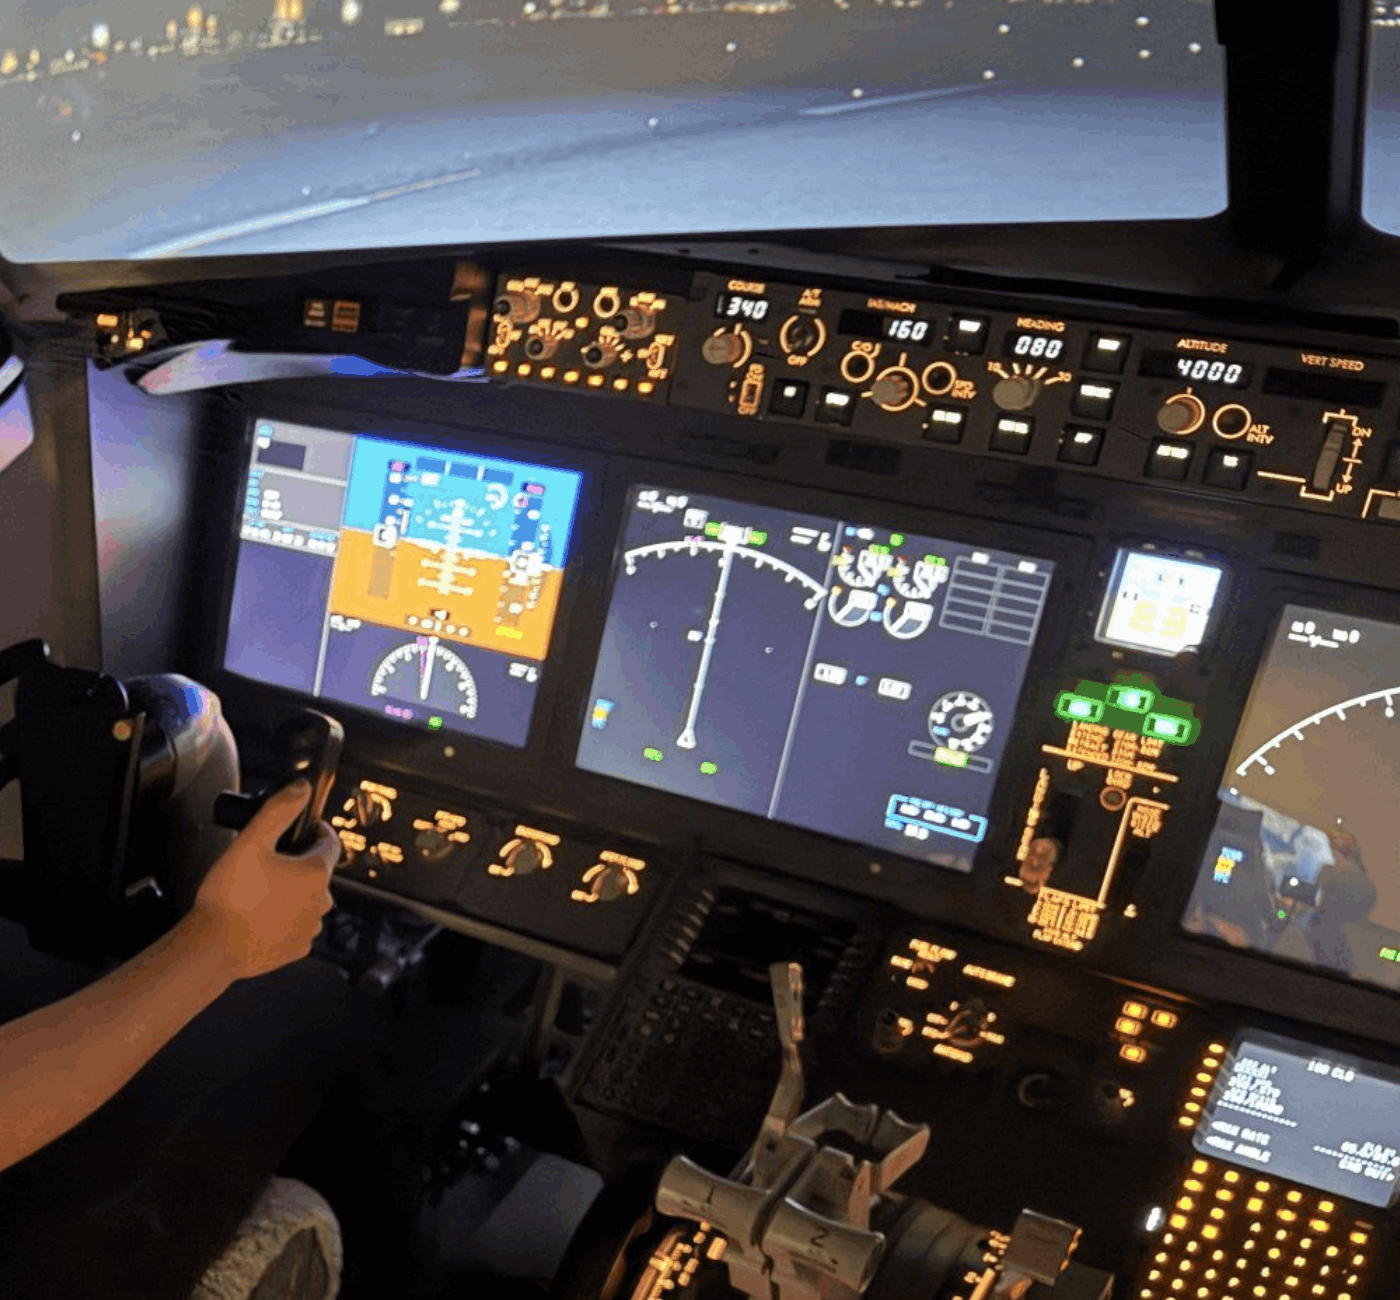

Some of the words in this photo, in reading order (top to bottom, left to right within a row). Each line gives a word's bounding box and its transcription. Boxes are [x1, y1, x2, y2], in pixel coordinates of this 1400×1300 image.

[726, 296, 769, 320] 340
[887, 319, 929, 341] 160
[1016, 317, 1066, 332] HEADING
[1014, 335, 1064, 359] 080
[1177, 337, 1230, 354] ALTITUDE
[1177, 358, 1242, 384] 4000
[1301, 353, 1328, 367] VERT
[1328, 356, 1365, 372] SPEED
[1248, 424, 1271, 434] ALT
[1351, 427, 1373, 438] DN
[1246, 434, 1274, 445] INTV
[1335, 483, 1353, 494] UP
[810, 1224, 830, 1248] 2
